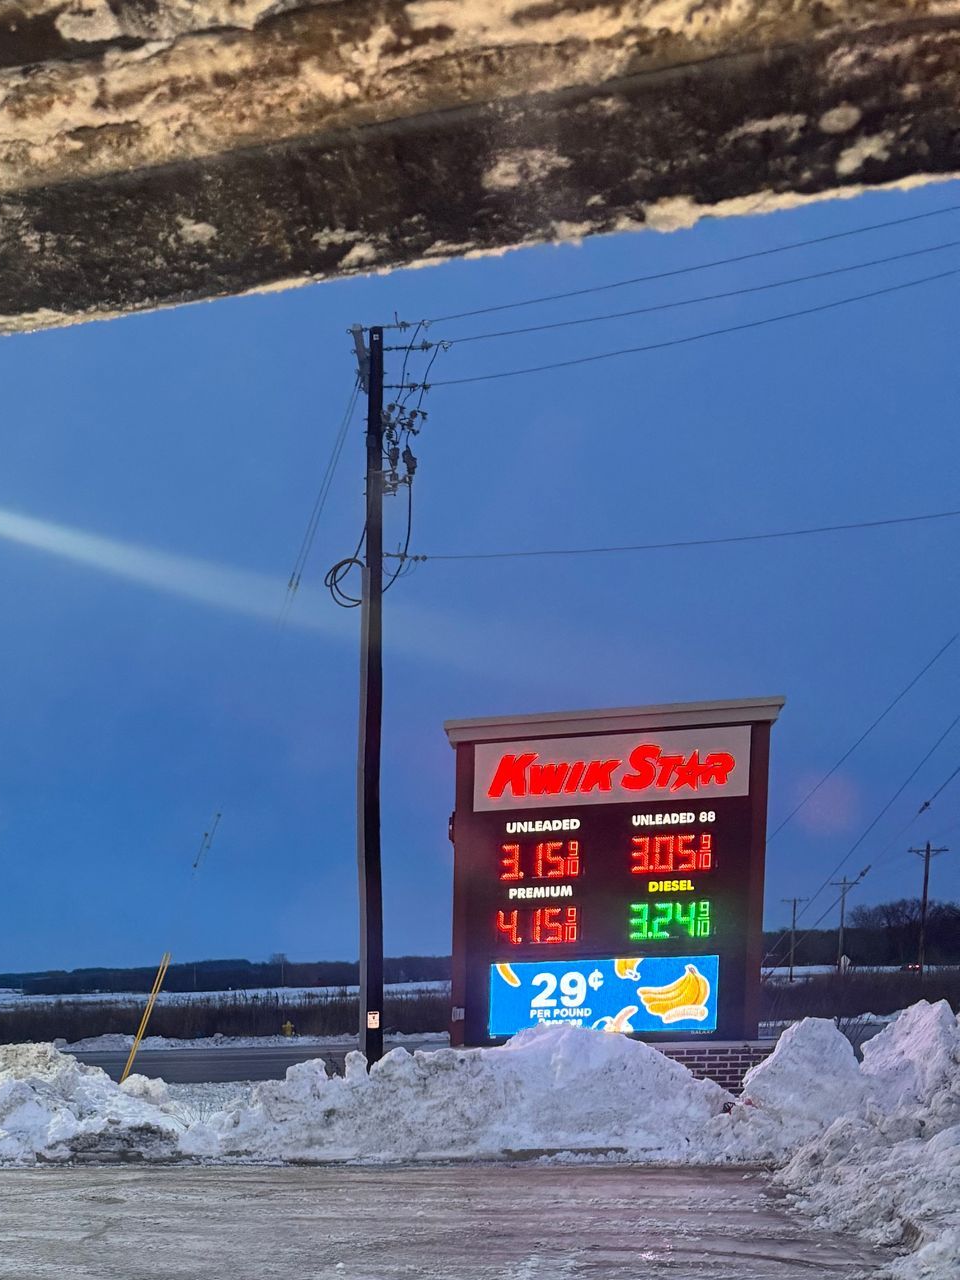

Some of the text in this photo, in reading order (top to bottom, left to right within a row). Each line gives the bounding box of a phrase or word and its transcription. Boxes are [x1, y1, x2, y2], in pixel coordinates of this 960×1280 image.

[506, 818, 581, 834] UNLEADED
[631, 811, 716, 826] UNLEADED 88
[509, 885, 573, 900] PREMIUM
[648, 880, 695, 893] DIESEL
[530, 1007, 592, 1018] PER POUND
